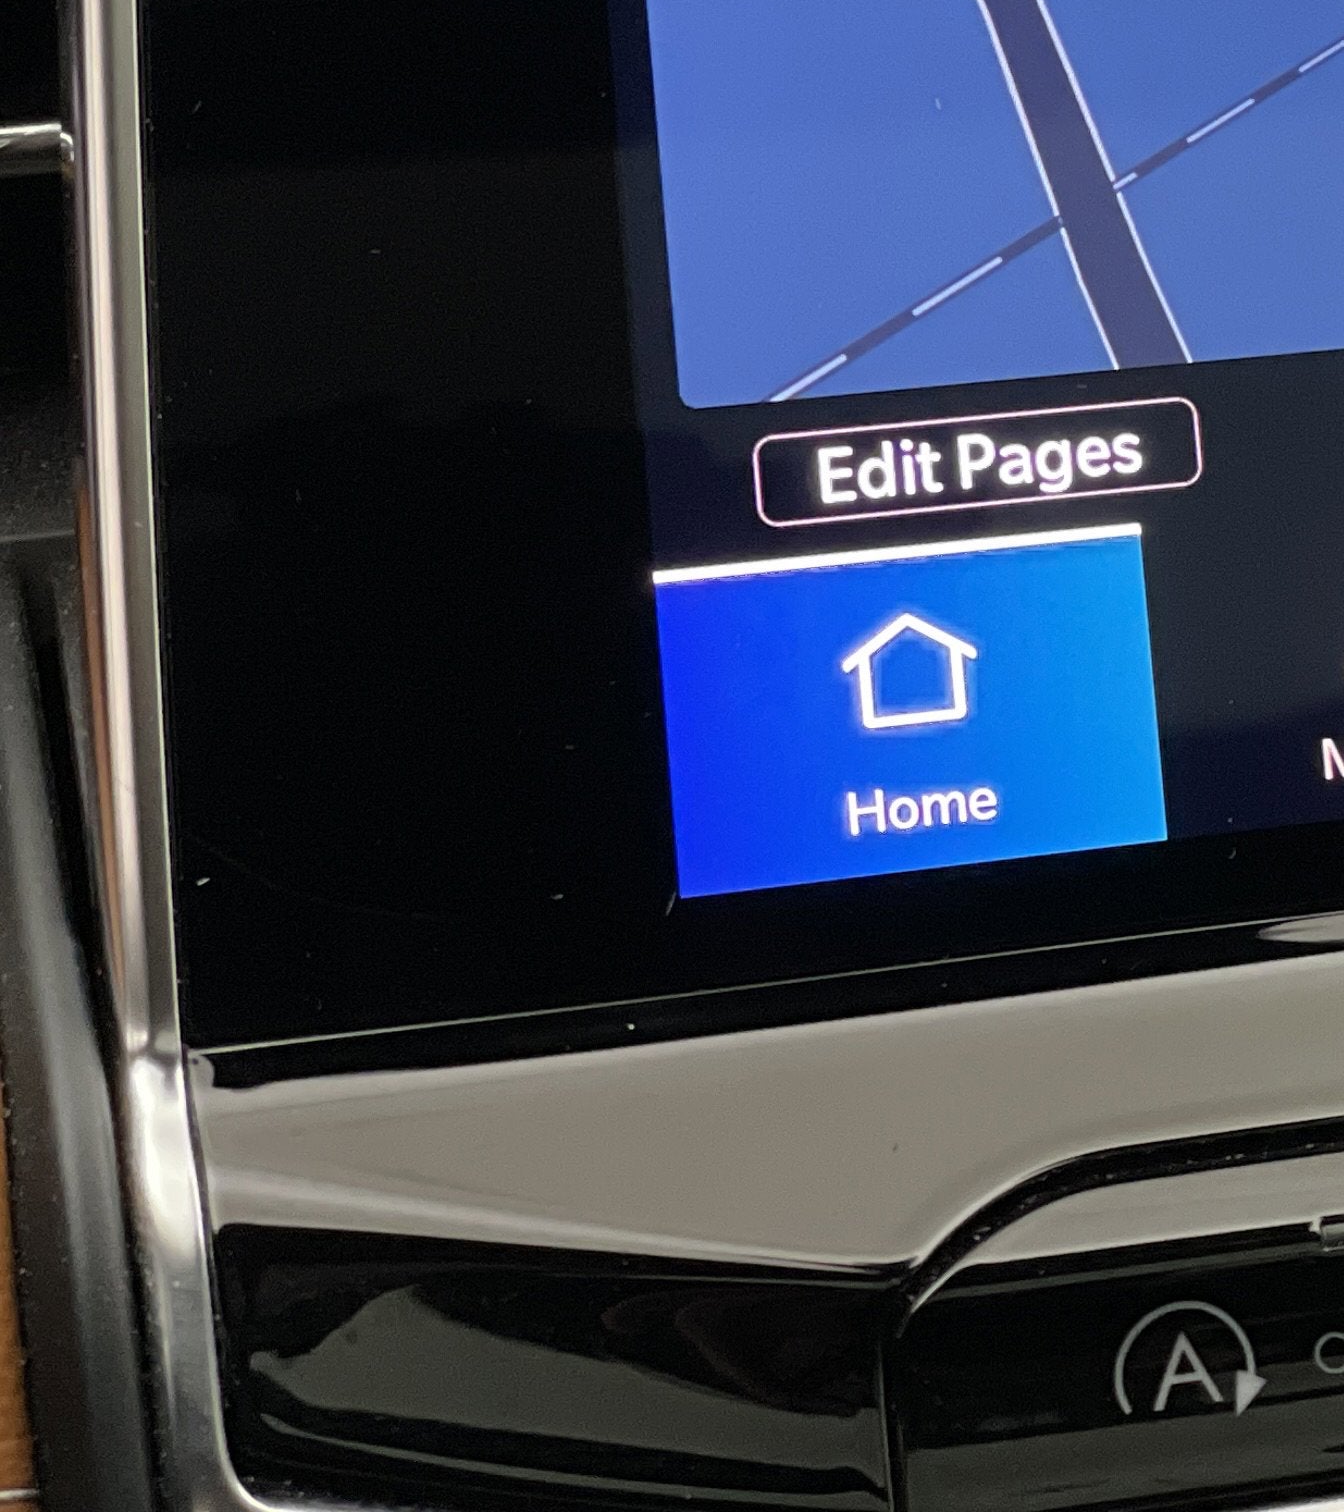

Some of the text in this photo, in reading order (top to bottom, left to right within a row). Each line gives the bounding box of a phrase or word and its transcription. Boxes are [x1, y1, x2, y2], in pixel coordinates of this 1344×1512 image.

[814, 424, 1144, 506] Edit Pages
[845, 781, 1000, 837] Home
